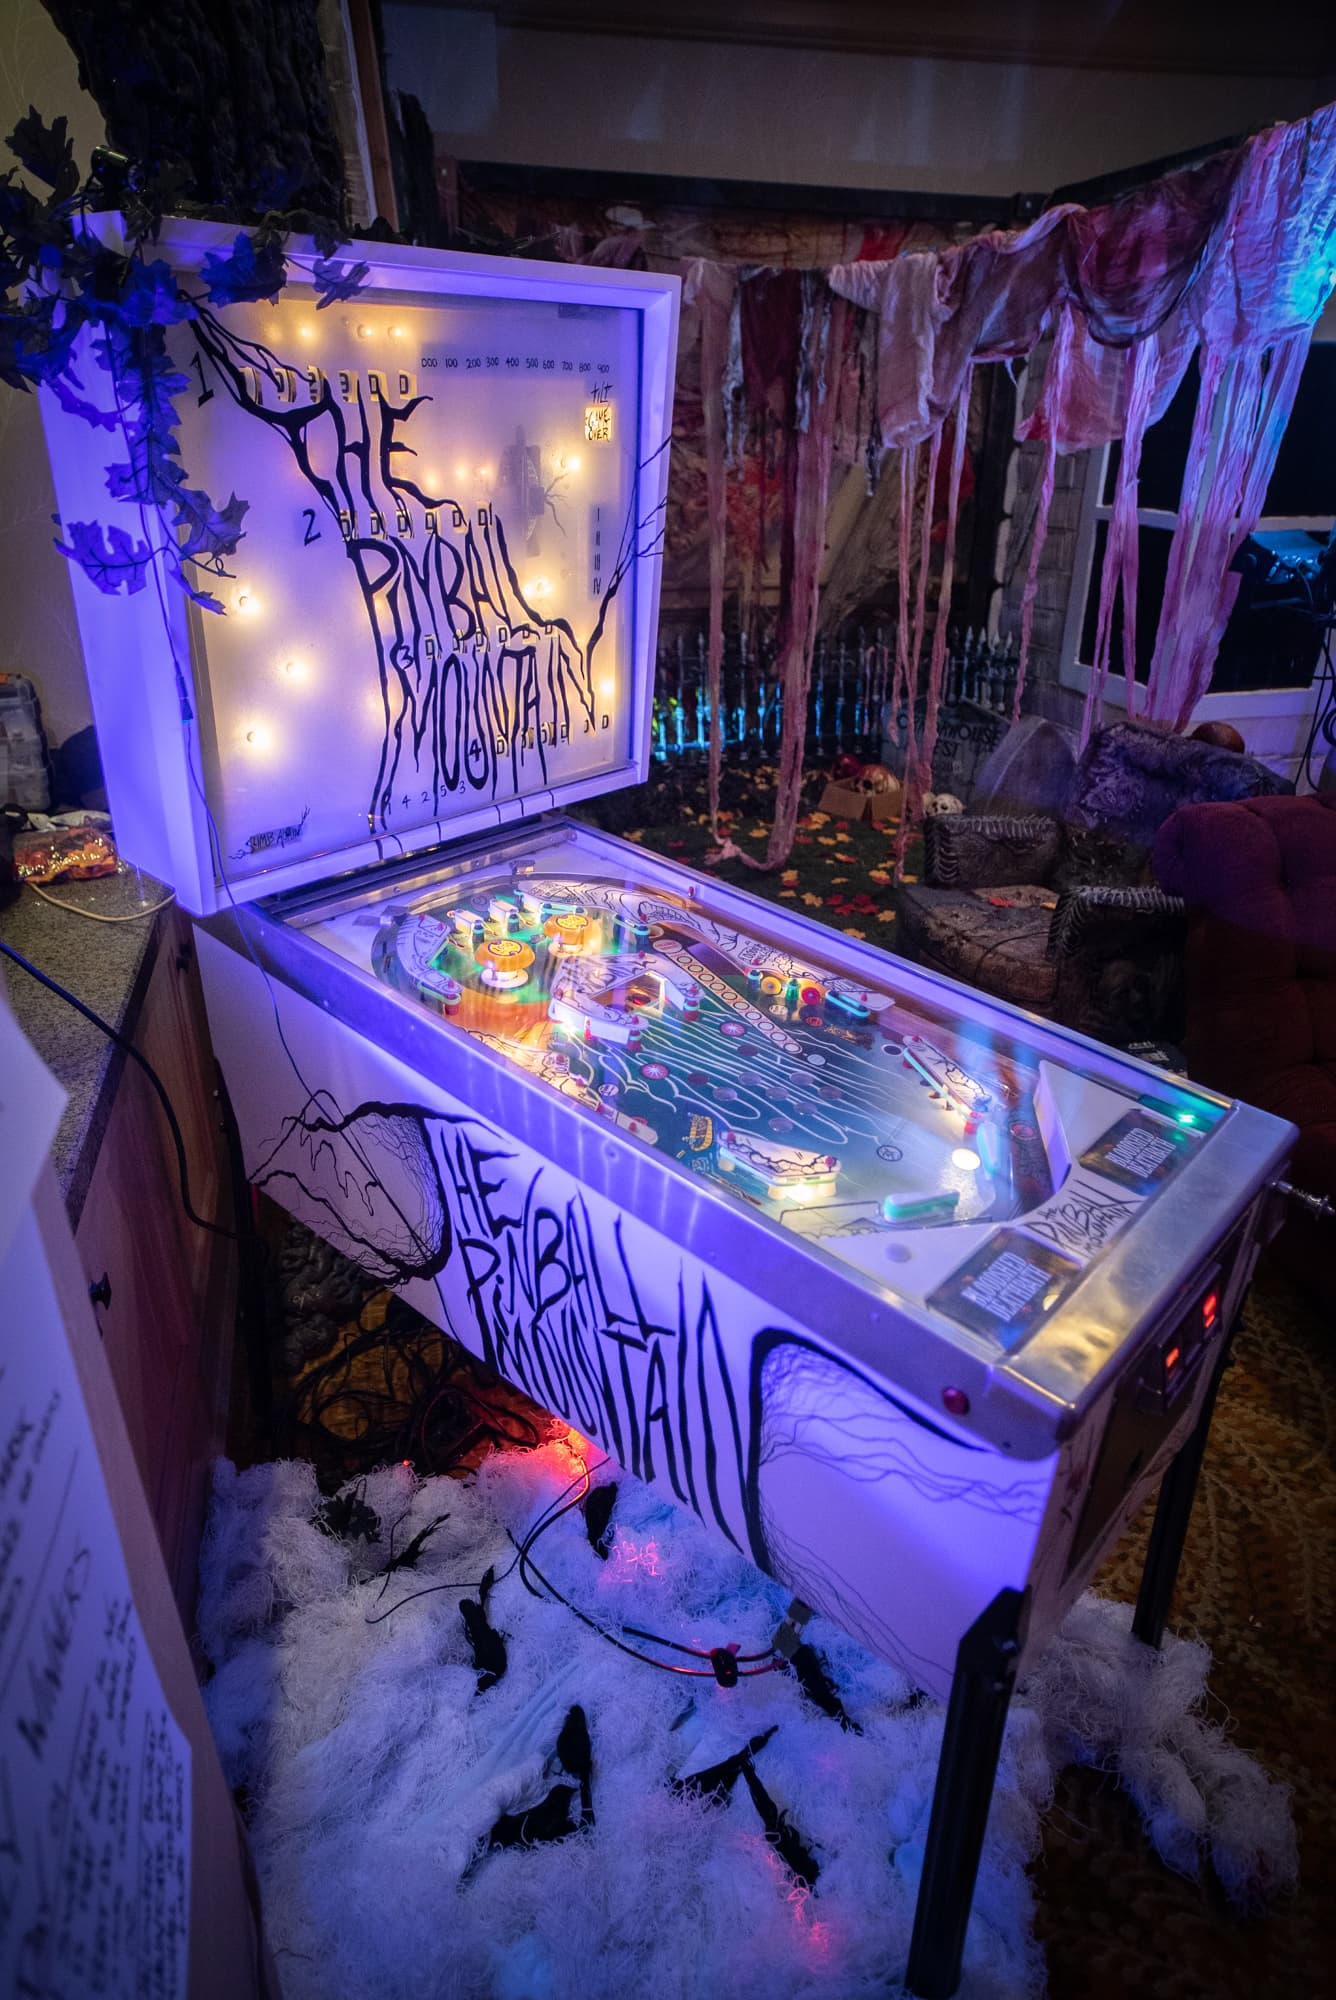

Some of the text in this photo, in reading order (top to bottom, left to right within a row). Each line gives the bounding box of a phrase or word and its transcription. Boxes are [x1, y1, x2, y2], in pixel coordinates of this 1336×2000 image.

[445, 357, 458, 369] 100
[466, 357, 481, 370] 200
[486, 356, 499, 368] 300
[505, 356, 520, 368] 400
[526, 357, 539, 369] 500
[561, 360, 573, 372] 700
[302, 508, 321, 547] 2
[1022, 1179, 1144, 1256] PINBALL
[457, 1167, 676, 1362] PINBALL
[490, 1258, 772, 1576] MOUNTAIN
